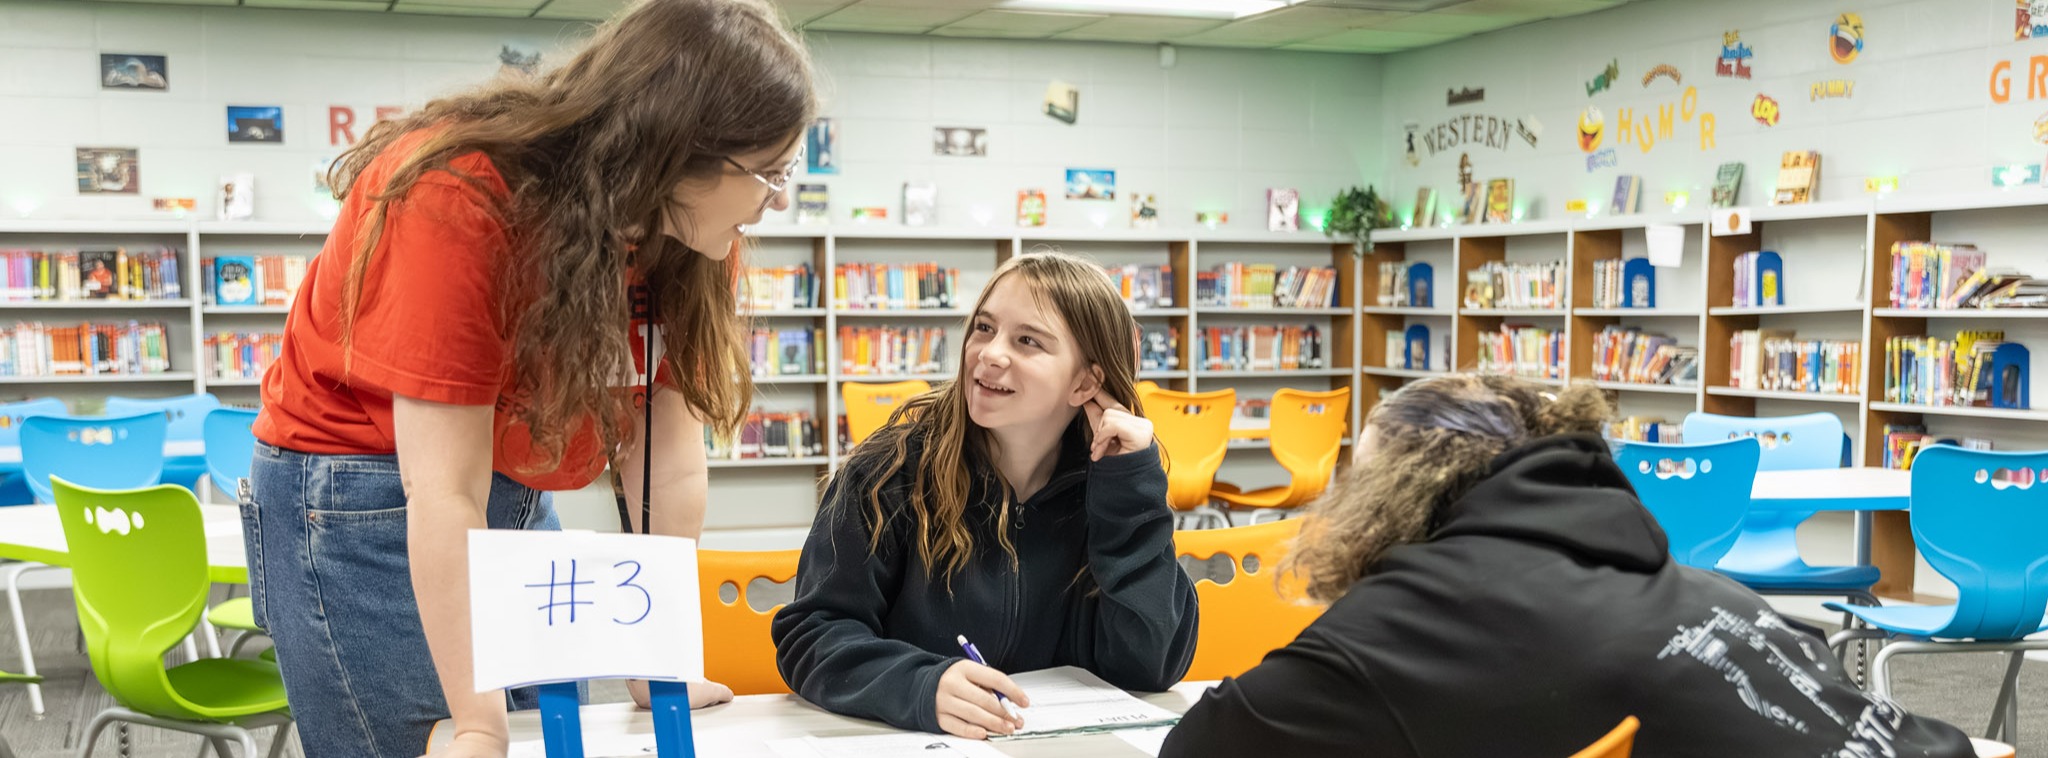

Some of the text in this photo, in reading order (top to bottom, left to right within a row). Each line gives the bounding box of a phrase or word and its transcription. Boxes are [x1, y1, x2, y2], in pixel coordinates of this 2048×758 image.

[1809, 80, 1856, 102] FUNNY
[1617, 85, 1716, 154] HUMOR
[1752, 95, 1779, 126] LOL
[1423, 115, 1512, 156] WESTERN
